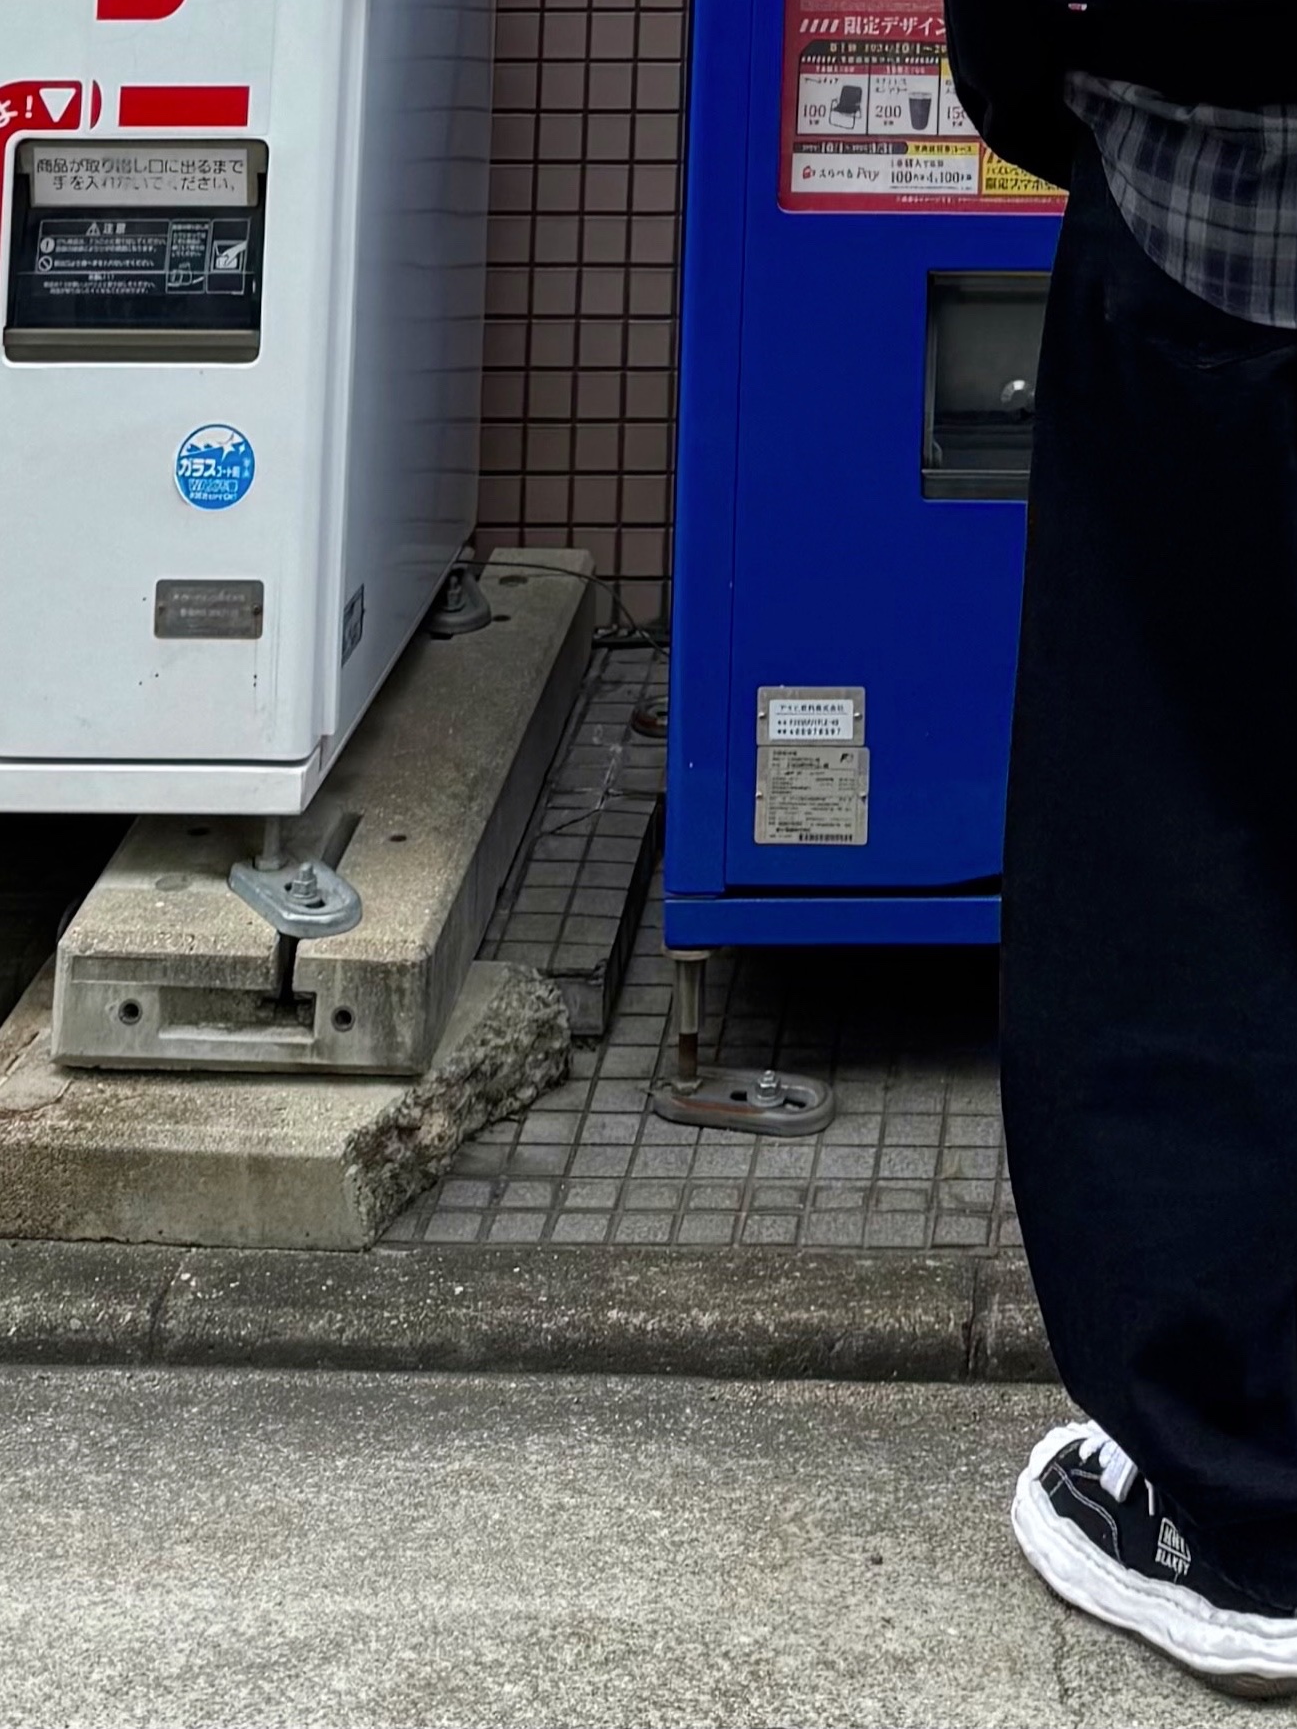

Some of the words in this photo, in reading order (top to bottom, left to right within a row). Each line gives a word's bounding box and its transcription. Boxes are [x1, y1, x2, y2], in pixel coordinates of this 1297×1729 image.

[803, 104, 827, 119] 100
[875, 105, 902, 119] 200
[103, 222, 127, 234] 注意
[178, 457, 217, 478] ガラス
